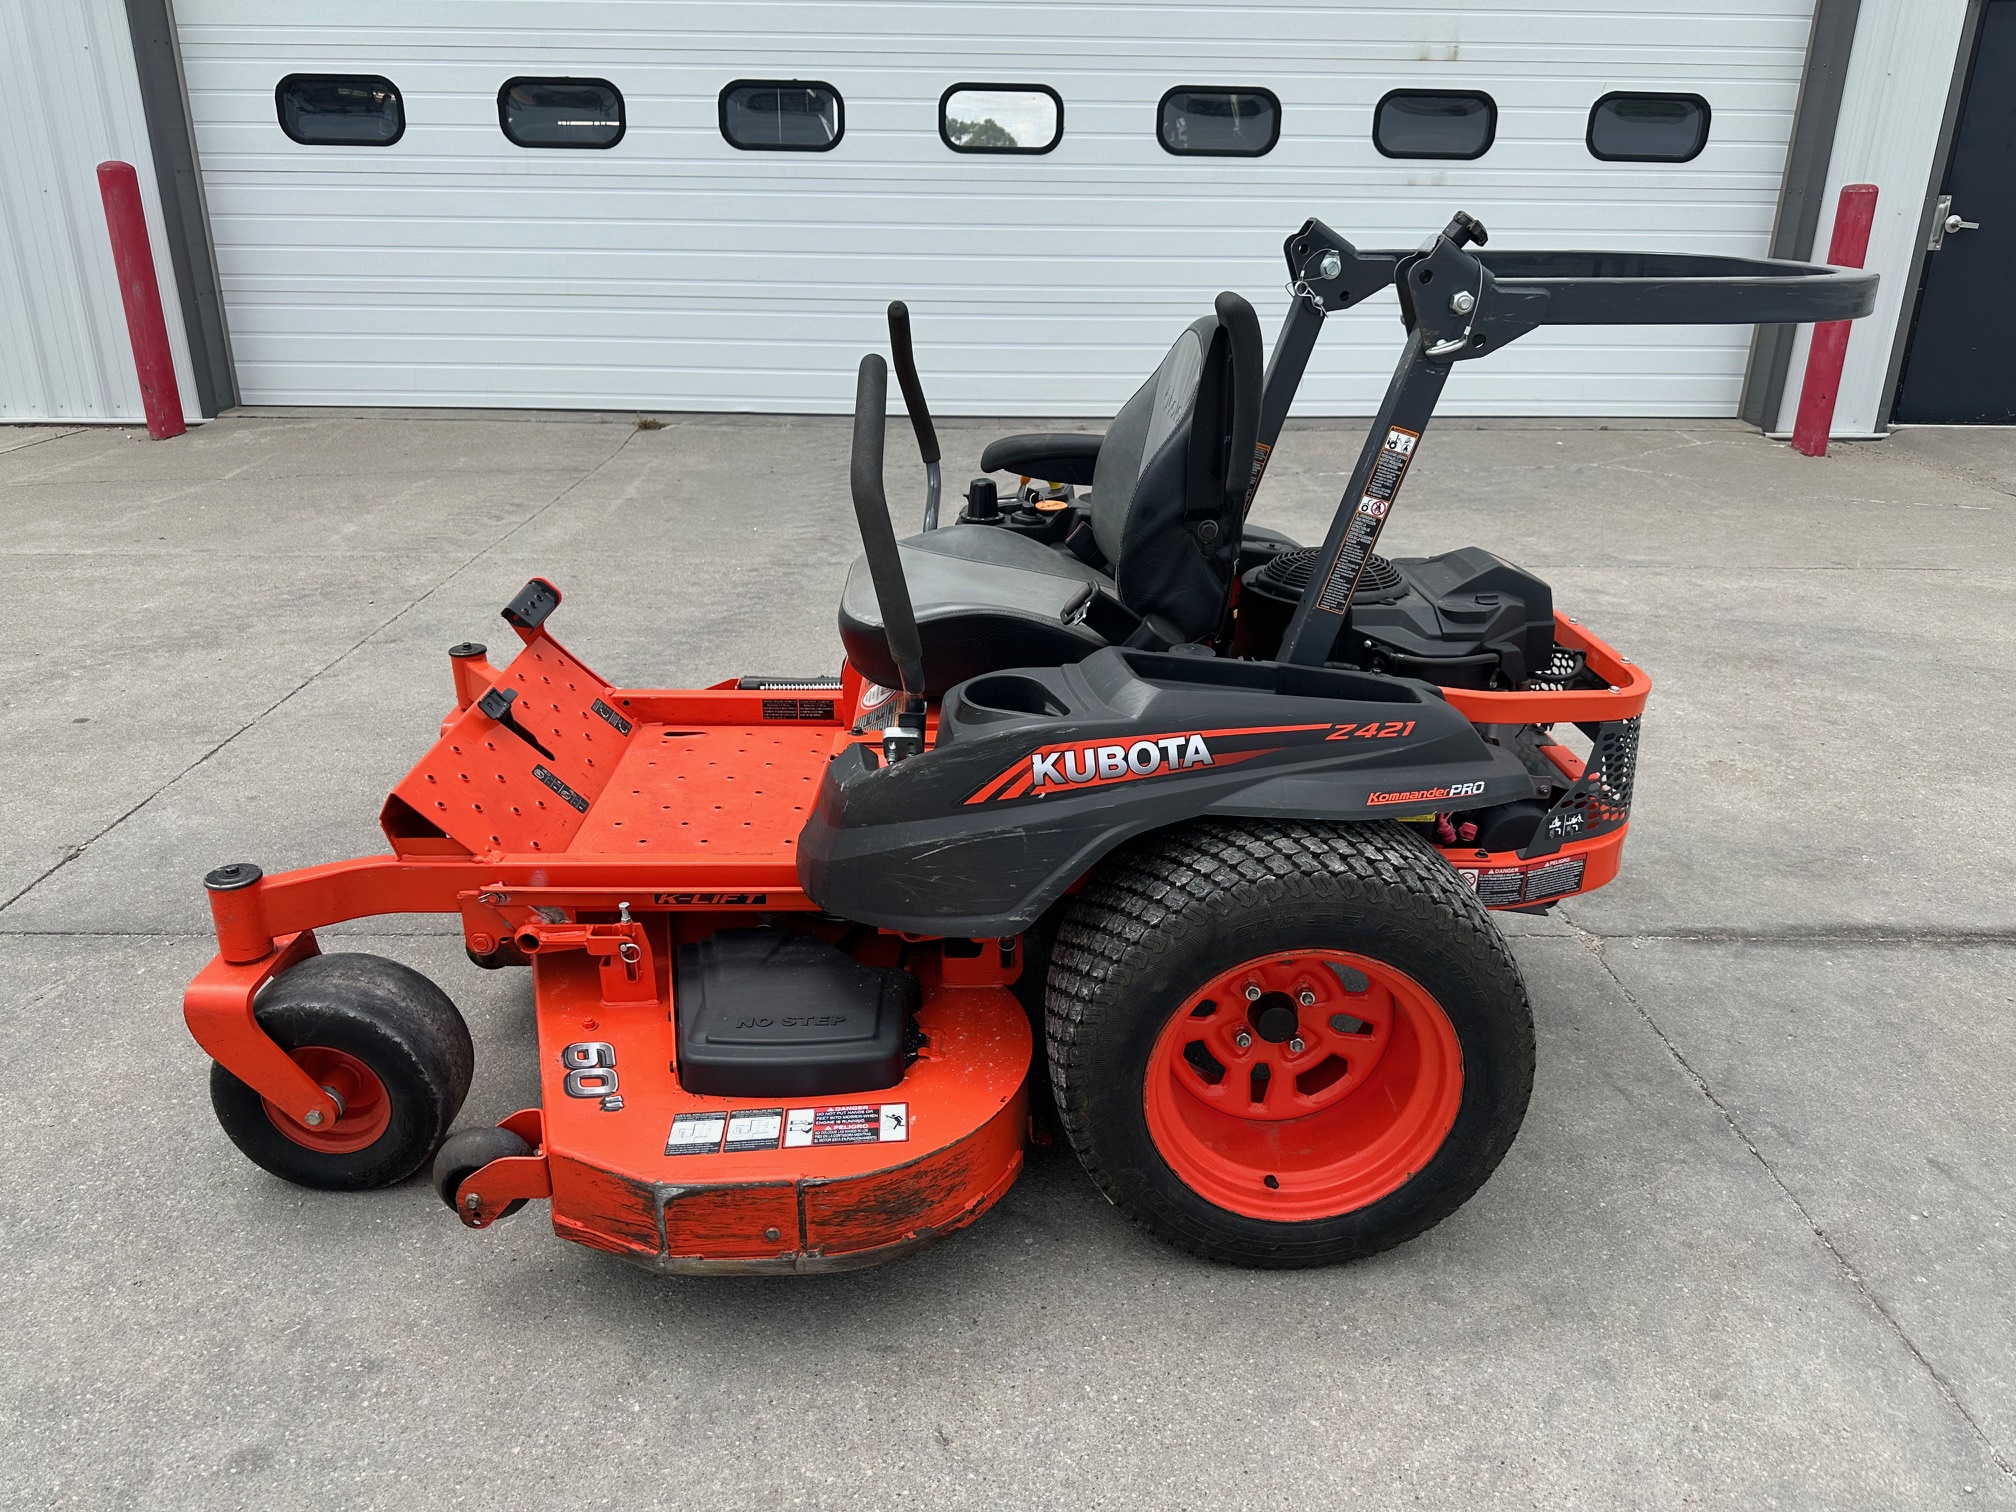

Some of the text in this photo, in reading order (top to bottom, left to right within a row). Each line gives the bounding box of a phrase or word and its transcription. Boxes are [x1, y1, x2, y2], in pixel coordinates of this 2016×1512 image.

[1325, 720, 1416, 741] Z421
[1031, 733, 1214, 786] KUBOTA
[1549, 857, 1571, 866] PELIGRO
[658, 893, 763, 904] K-LIFT
[736, 1015, 847, 1029] NO STEP
